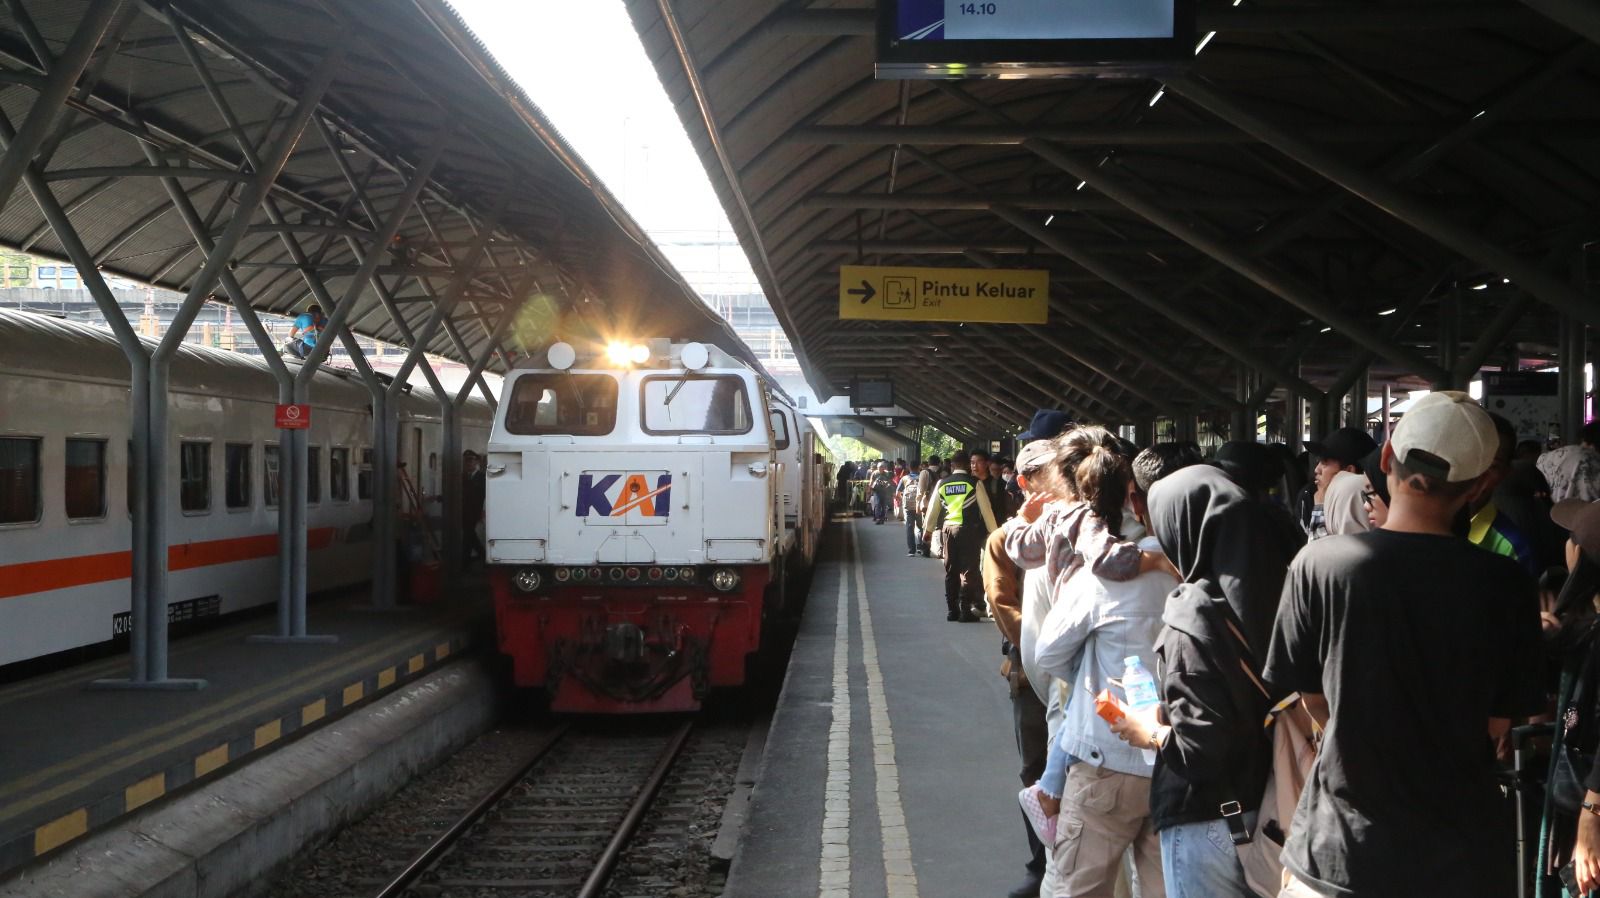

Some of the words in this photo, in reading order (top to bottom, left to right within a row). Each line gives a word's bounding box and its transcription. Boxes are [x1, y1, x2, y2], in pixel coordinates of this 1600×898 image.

[960, 3, 996, 15] 14.10
[922, 281, 970, 297] Pintu
[976, 282, 1035, 298] Keluar
[922, 298, 941, 307] Exit
[576, 475, 671, 516] KAI
